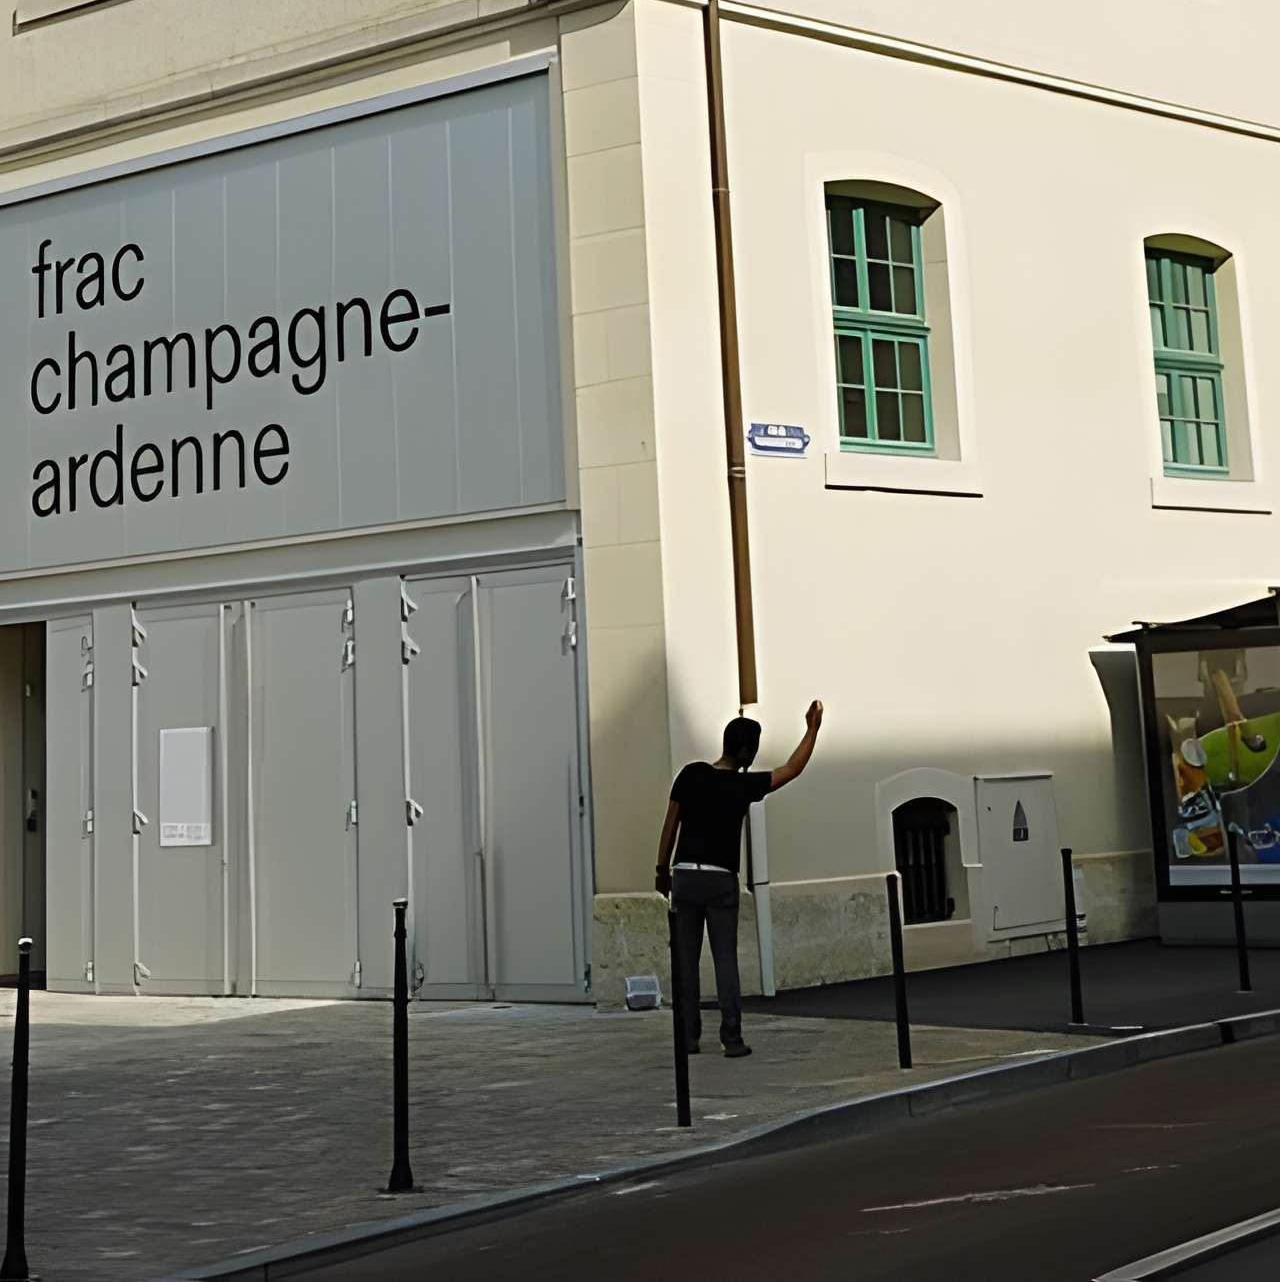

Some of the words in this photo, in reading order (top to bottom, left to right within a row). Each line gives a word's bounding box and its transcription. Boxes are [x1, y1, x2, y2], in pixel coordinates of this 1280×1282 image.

[31, 239, 145, 319] frac
[30, 288, 451, 415] champagne-
[31, 423, 290, 518] ardenne
